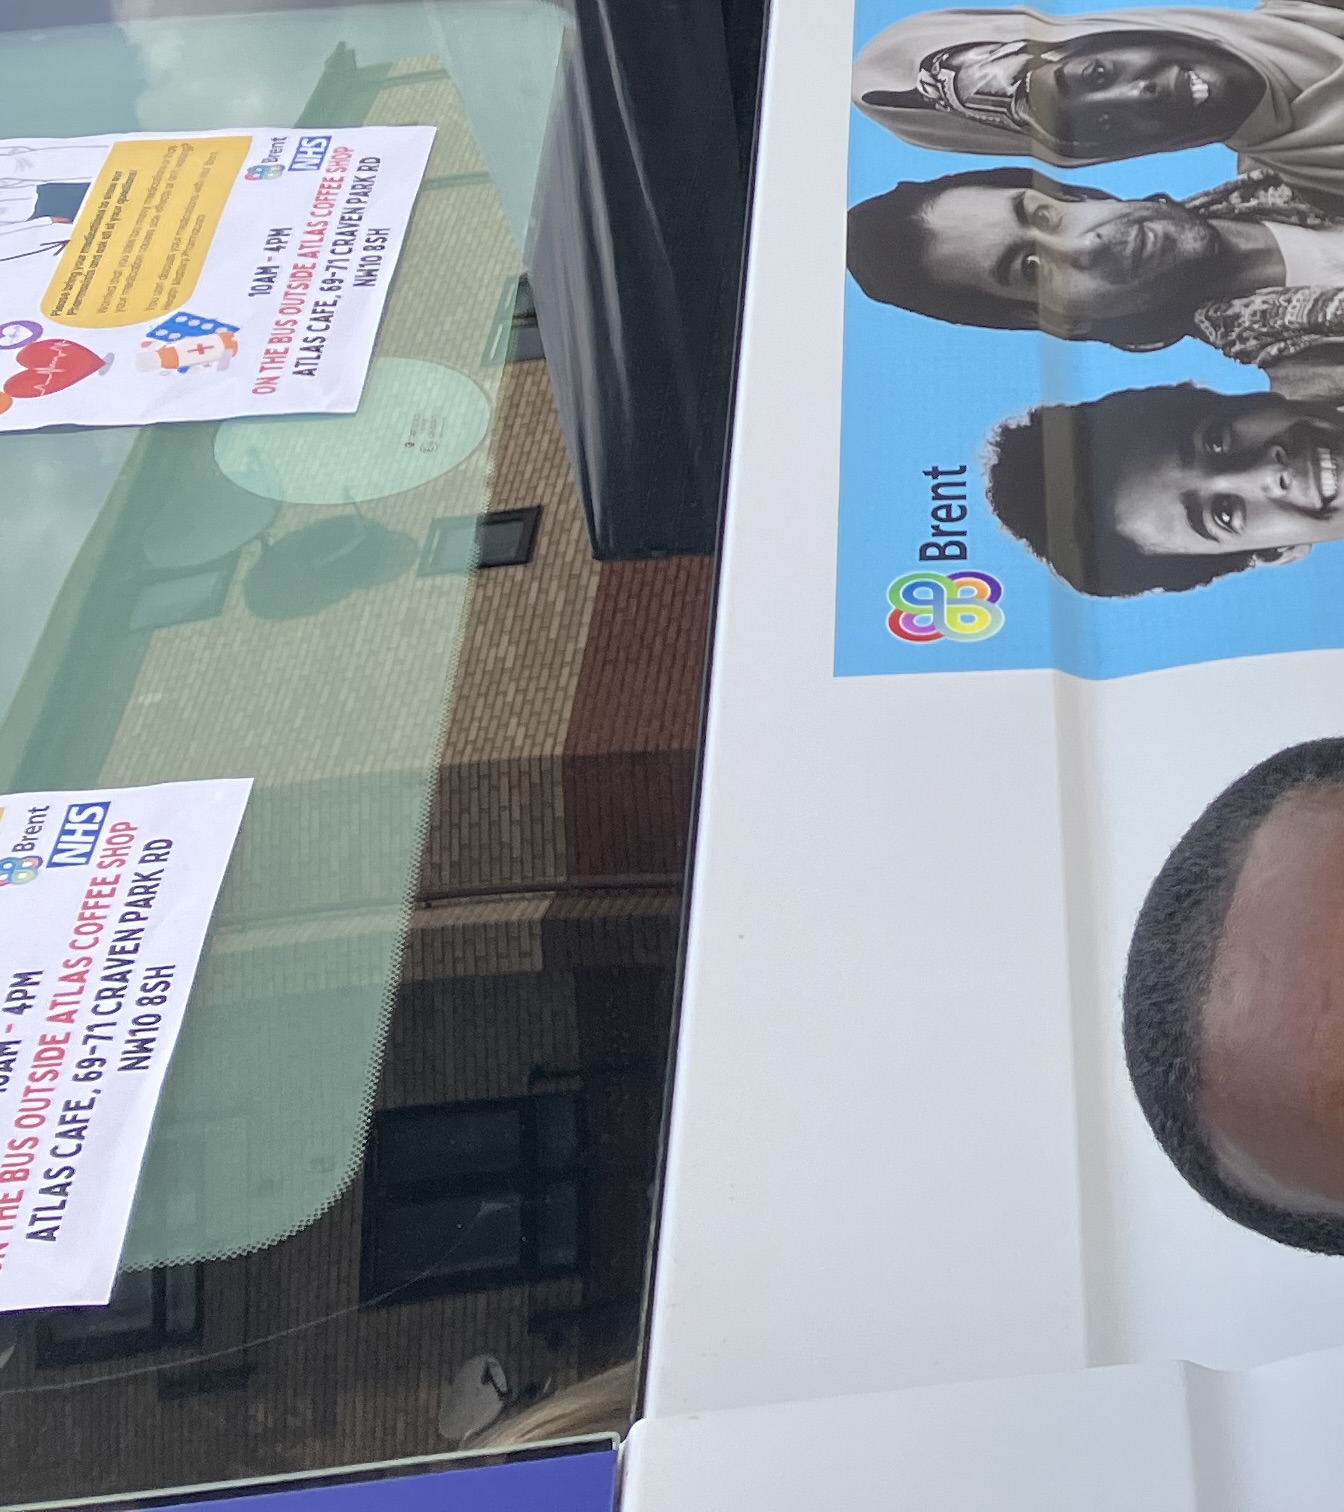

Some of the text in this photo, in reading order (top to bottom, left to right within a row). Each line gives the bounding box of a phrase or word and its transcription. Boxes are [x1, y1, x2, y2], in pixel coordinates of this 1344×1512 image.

[261, 137, 288, 163] Brent
[291, 137, 328, 168] NHS
[263, 227, 292, 252] 4PM
[292, 157, 381, 376] ATLAS CAFE, 69-71 CRAVEN PARK RD
[352, 227, 390, 287] NW10 8SH
[248, 265, 280, 297] 10AM
[252, 146, 354, 395] ON THE BUS OUTSIDE ATLAS COFFEE SHOP
[918, 464, 969, 562] Brent
[11, 804, 50, 853] Brent
[51, 806, 105, 864] NHS
[96, 820, 138, 870] SHOP
[138, 838, 174, 864] RD
[69, 874, 121, 950] COFFEE
[118, 868, 165, 924] PARK
[3, 970, 44, 1015] 4PM
[46, 956, 94, 1024] ATLAS
[90, 928, 146, 1016] CRAVEN
[117, 964, 176, 1072] NW10 8SH
[14, 1032, 71, 1129] OUTSIDE
[71, 1022, 118, 1082] 69-71
[0, 1136, 40, 1182] BUS
[25, 1165, 76, 1242] ATLAS
